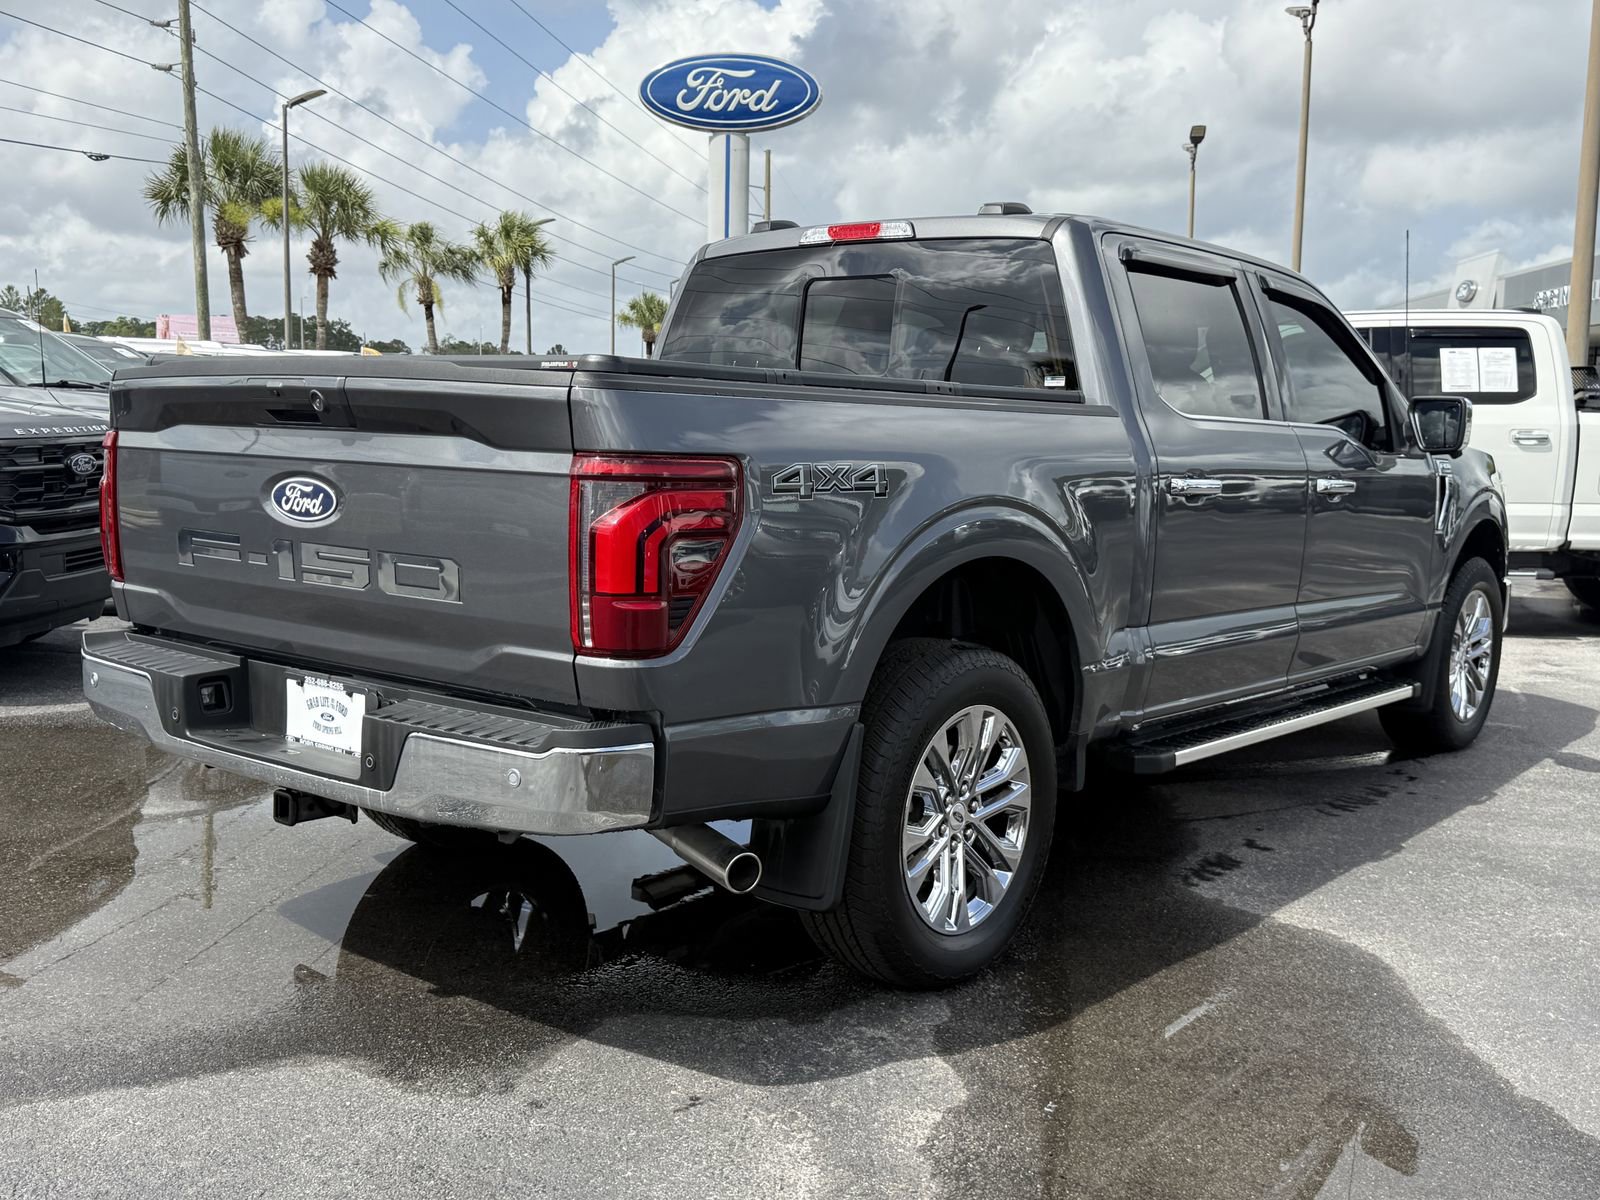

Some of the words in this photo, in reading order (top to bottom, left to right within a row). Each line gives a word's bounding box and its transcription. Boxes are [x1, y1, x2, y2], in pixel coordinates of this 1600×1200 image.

[676, 67, 783, 112] Ford
[13, 424, 109, 435] EXPEDITION
[75, 457, 93, 472] Ford
[281, 482, 324, 515] Ford
[178, 527, 463, 604] F-150
